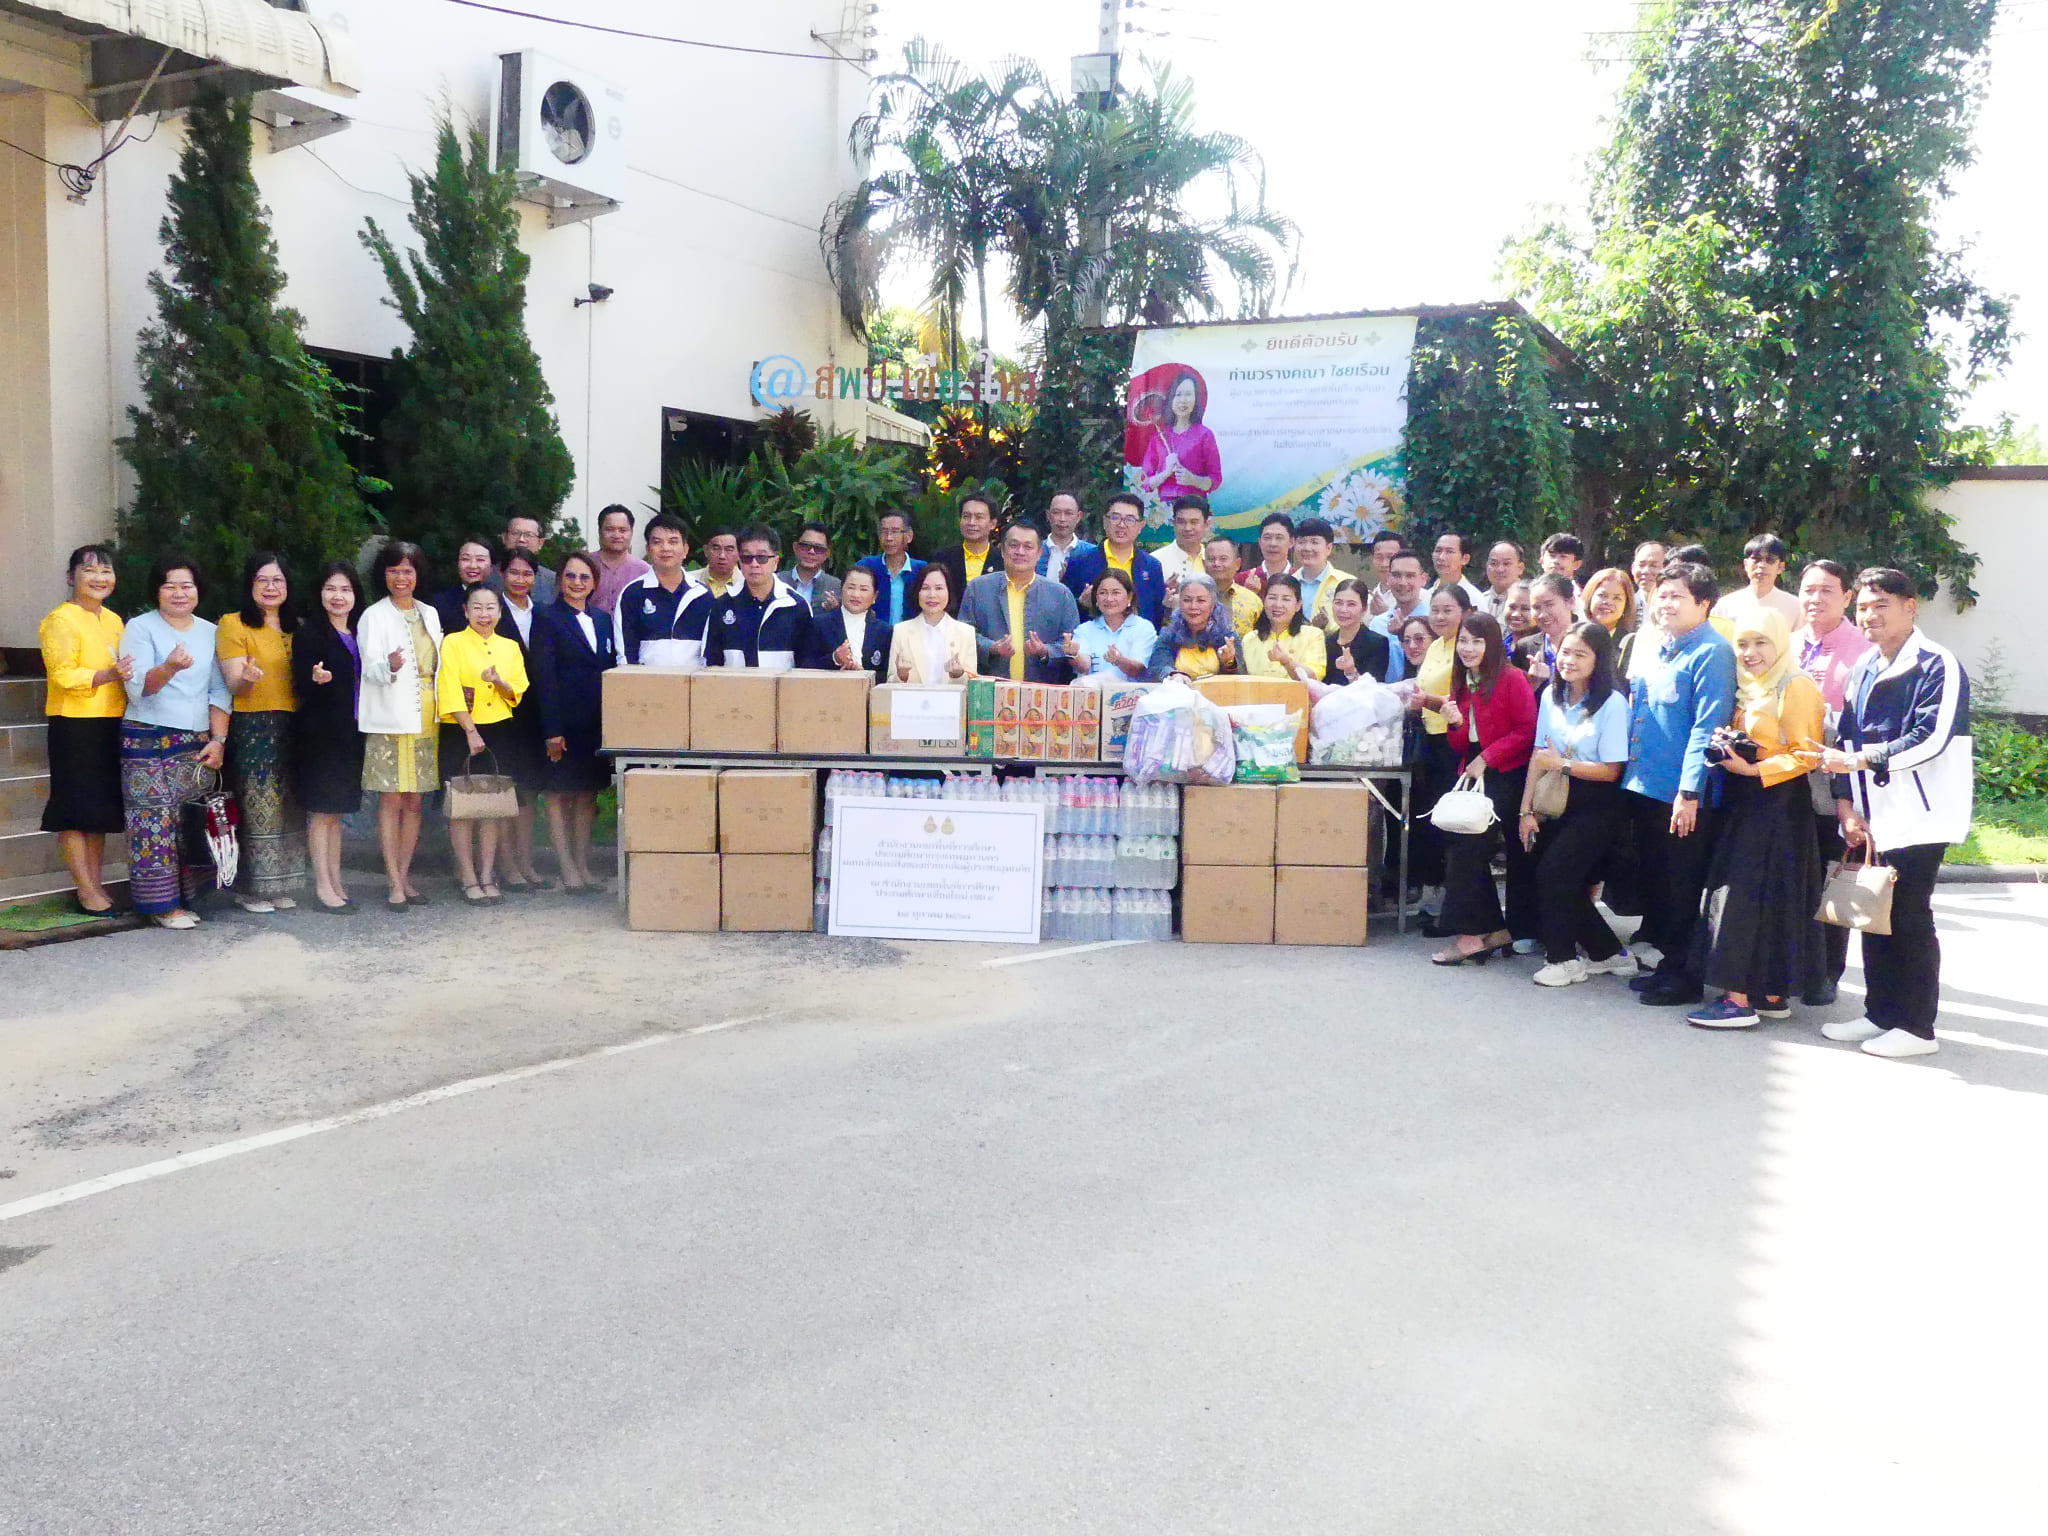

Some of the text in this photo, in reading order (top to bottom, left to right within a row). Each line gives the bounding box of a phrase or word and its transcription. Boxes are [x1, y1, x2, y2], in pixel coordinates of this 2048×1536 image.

[1266, 332, 1358, 350] ยินดีต้อนรับ
[1229, 367, 1325, 381] ท่านวรางคณา
